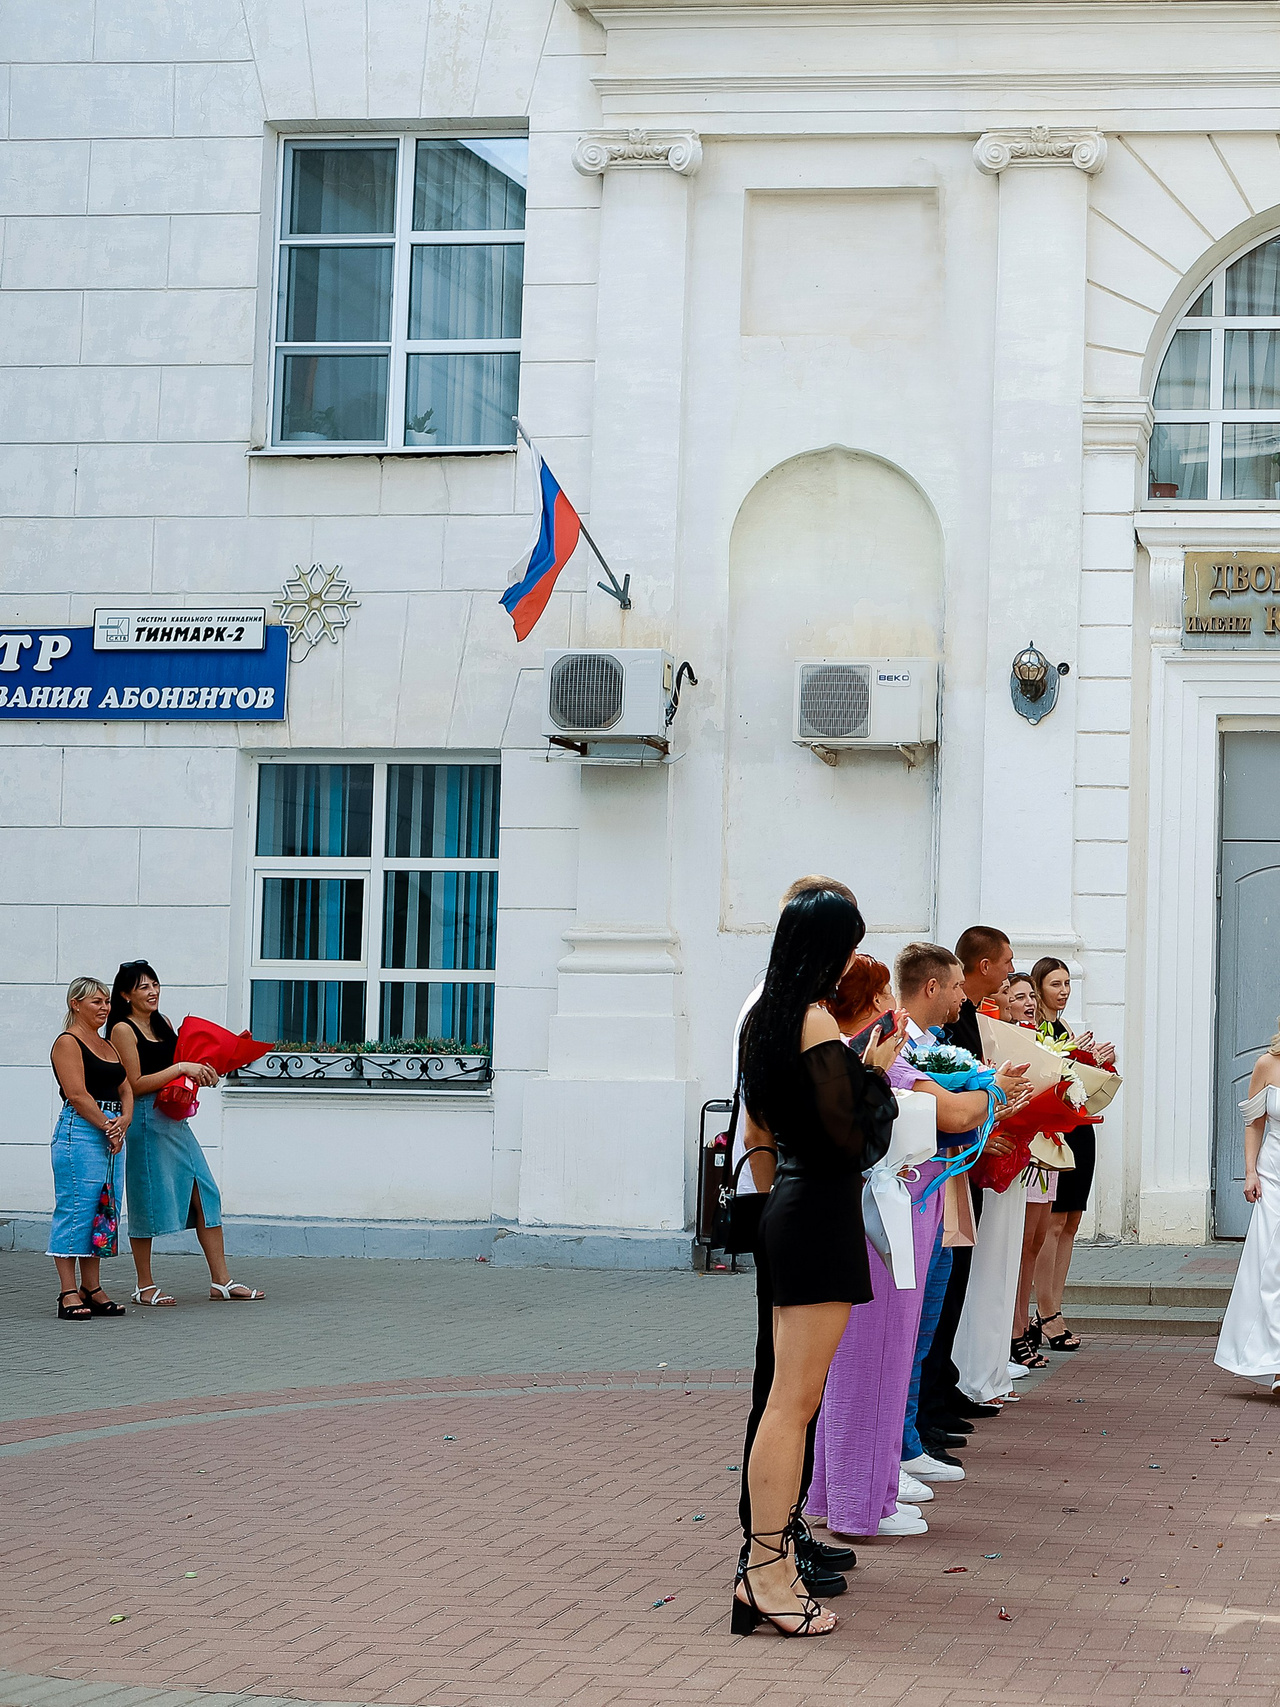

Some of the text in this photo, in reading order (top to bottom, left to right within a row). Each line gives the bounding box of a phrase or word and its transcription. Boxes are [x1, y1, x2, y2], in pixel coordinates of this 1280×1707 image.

[134, 626, 246, 642] ТИНМАРК-2
[1185, 616, 1253, 635] ИМЕНИ
[98, 686, 276, 709] АБОНЕНТОВ
